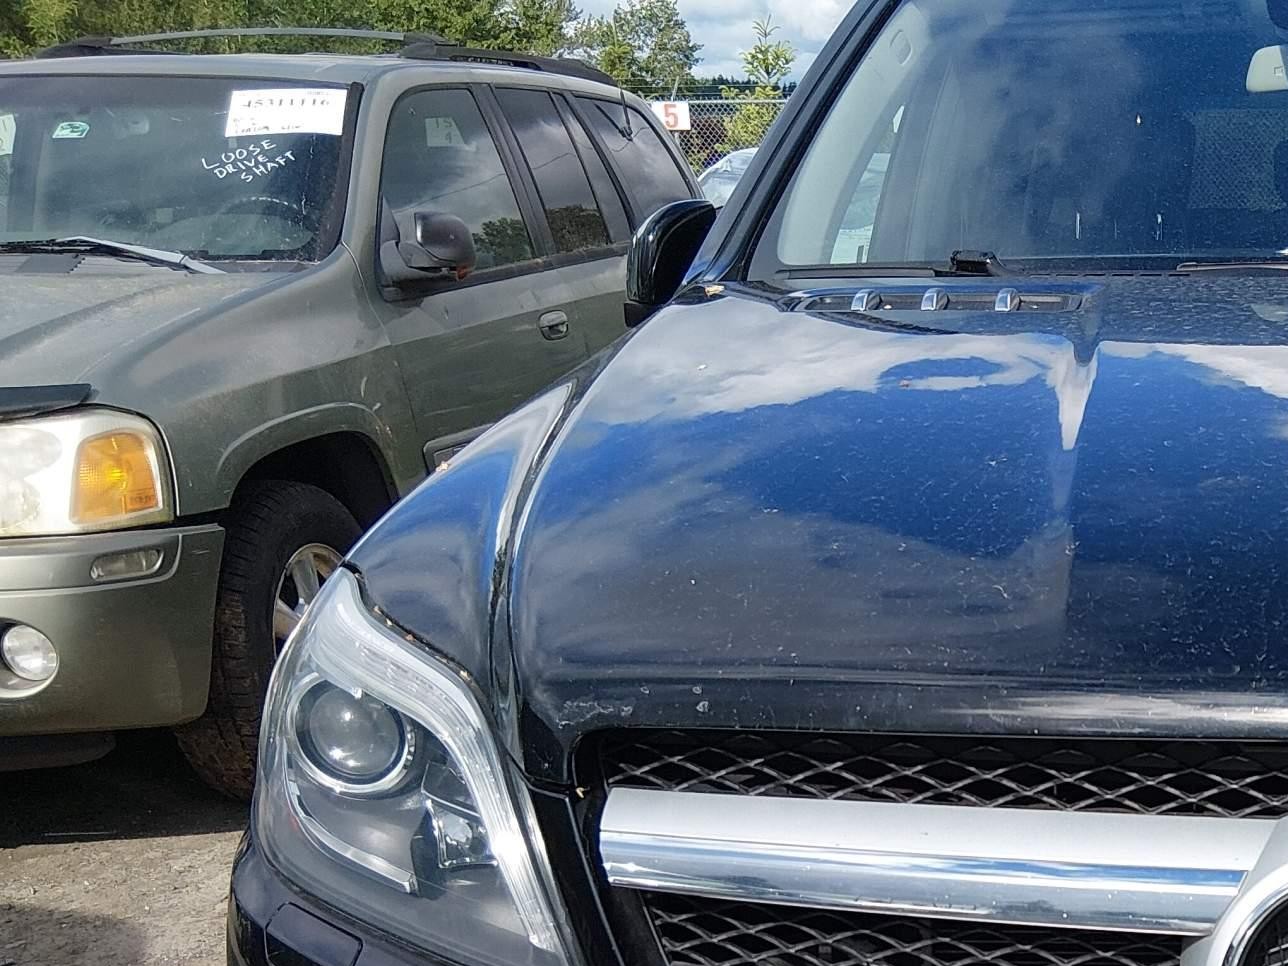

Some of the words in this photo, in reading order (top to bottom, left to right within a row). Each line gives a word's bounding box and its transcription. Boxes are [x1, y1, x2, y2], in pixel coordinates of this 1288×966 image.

[664, 103, 679, 128] 5
[201, 139, 277, 170] LOOSE
[213, 154, 269, 179] DRIVE
[240, 151, 296, 183] SHAFT
